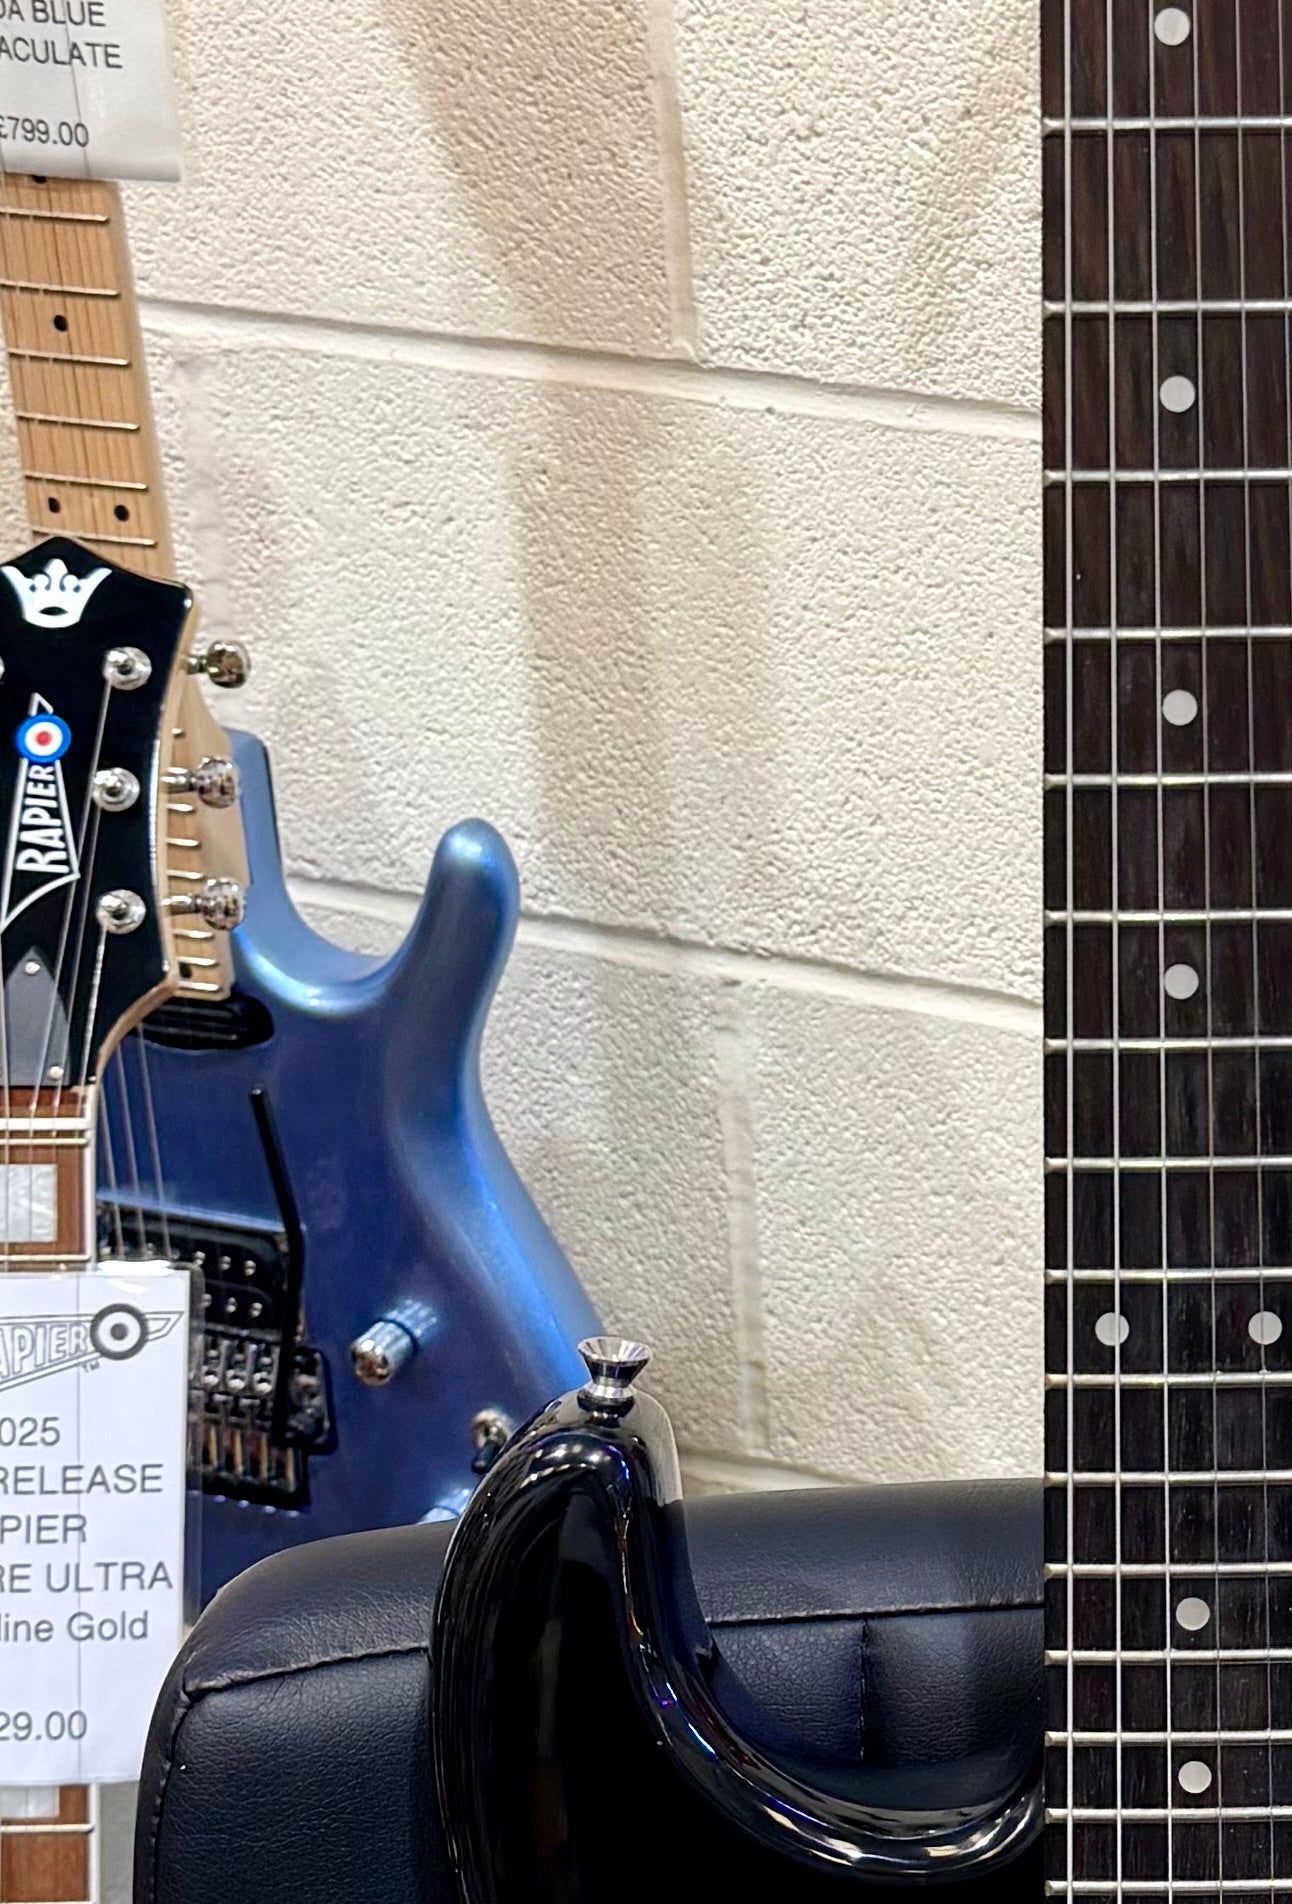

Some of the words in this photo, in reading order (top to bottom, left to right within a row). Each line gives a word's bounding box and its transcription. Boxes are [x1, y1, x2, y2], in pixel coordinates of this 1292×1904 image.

[15, 765, 70, 874] RAPIER
[46, 1560, 173, 1593] ULTRA
[67, 1609, 148, 1642] Gold
